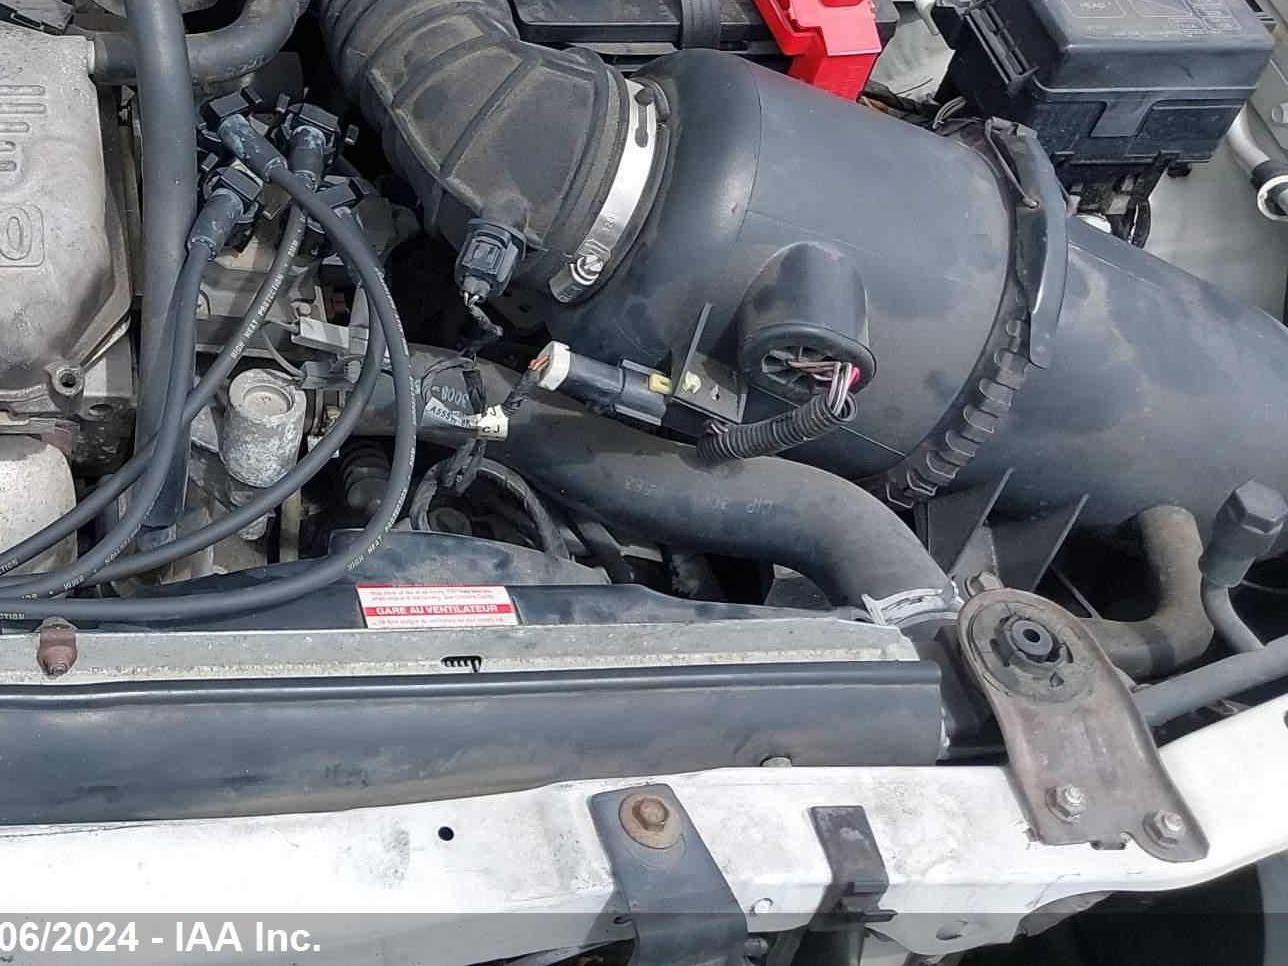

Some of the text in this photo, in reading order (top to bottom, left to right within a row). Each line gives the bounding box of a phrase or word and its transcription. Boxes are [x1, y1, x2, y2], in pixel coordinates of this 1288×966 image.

[257, 273, 285, 316] PROTECTION
[376, 604, 499, 615] GARE AU VENTILATEUR
